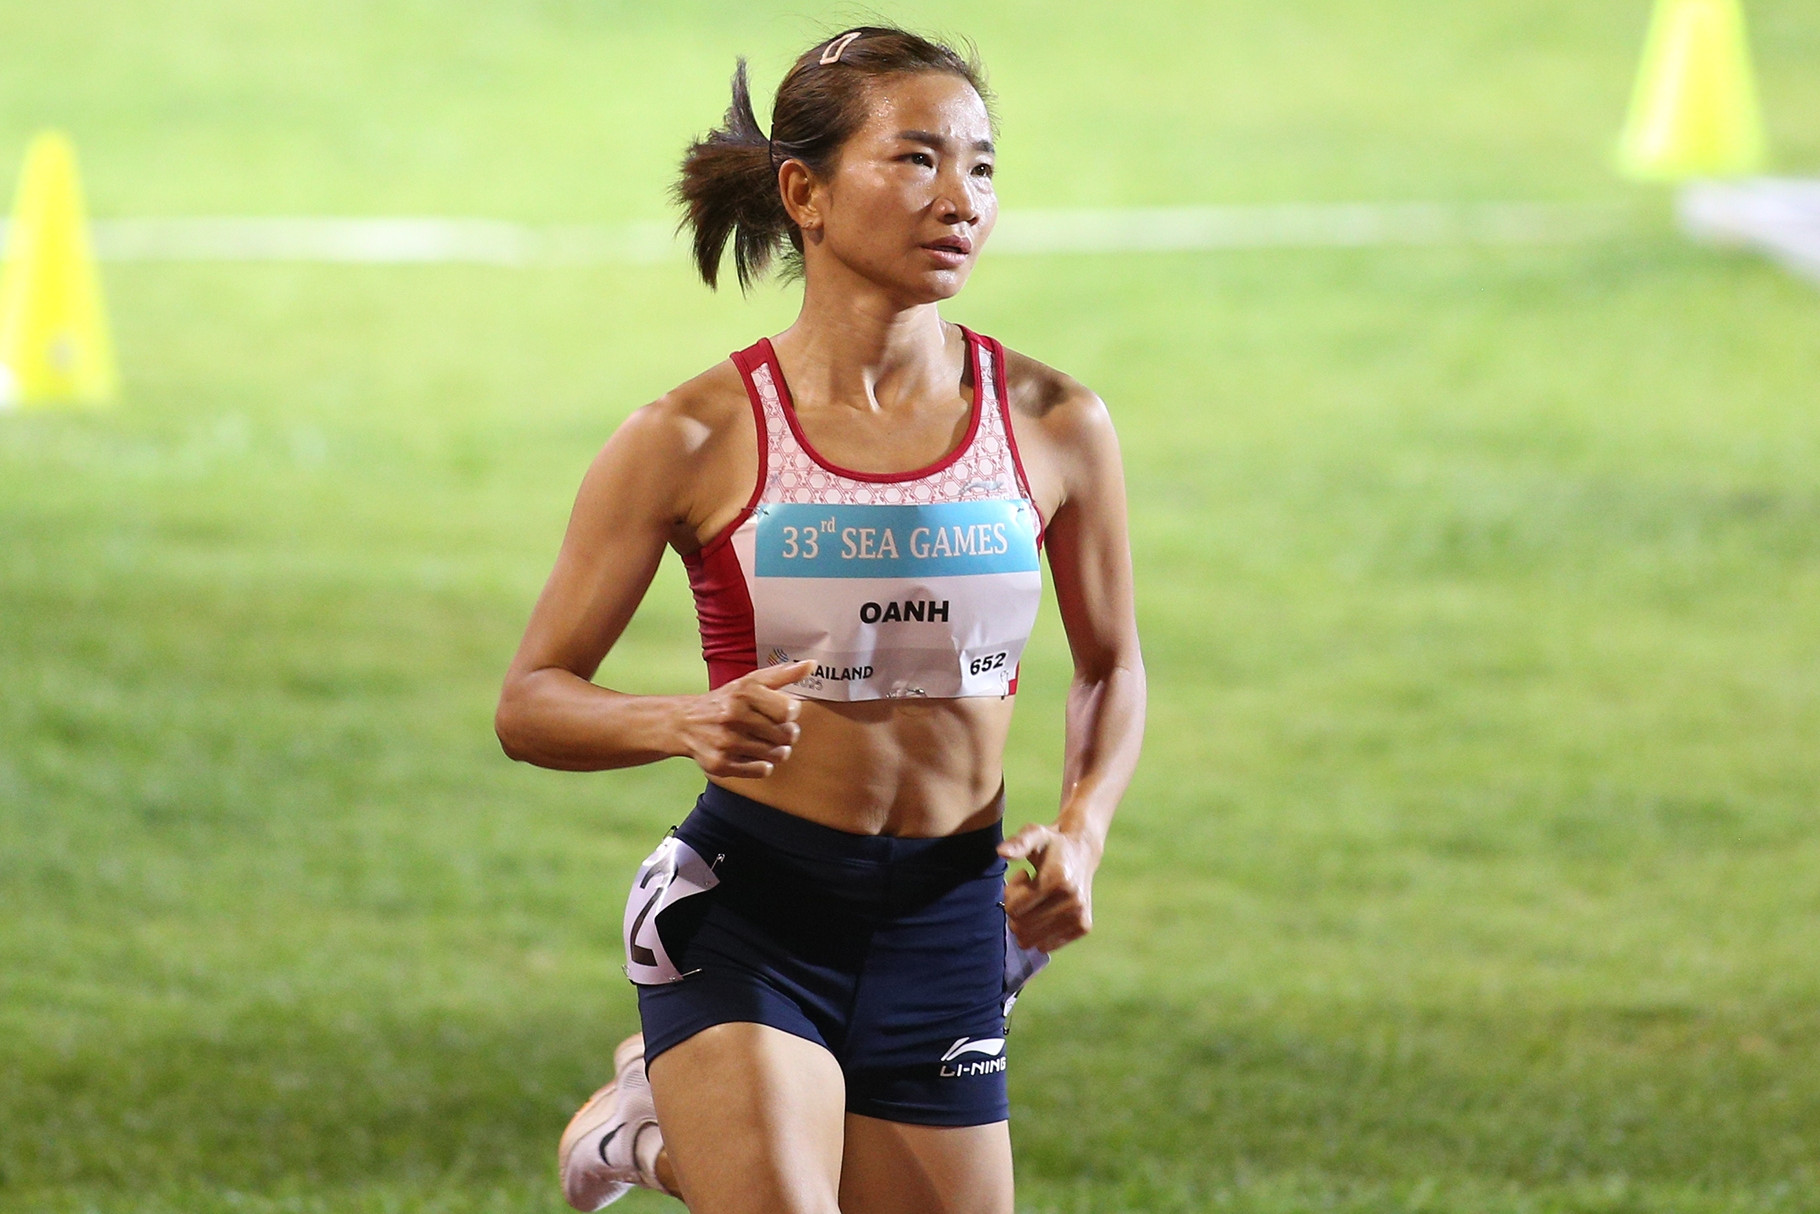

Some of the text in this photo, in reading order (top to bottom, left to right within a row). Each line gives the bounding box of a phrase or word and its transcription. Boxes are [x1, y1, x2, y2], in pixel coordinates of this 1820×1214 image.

[782, 516, 1008, 559] 33rd SEA GAMES
[860, 600, 949, 623] OANH
[793, 660, 874, 681] AILAND
[970, 652, 1006, 675] 652
[630, 861, 679, 967] 2
[940, 1056, 1006, 1077] LI-NING
